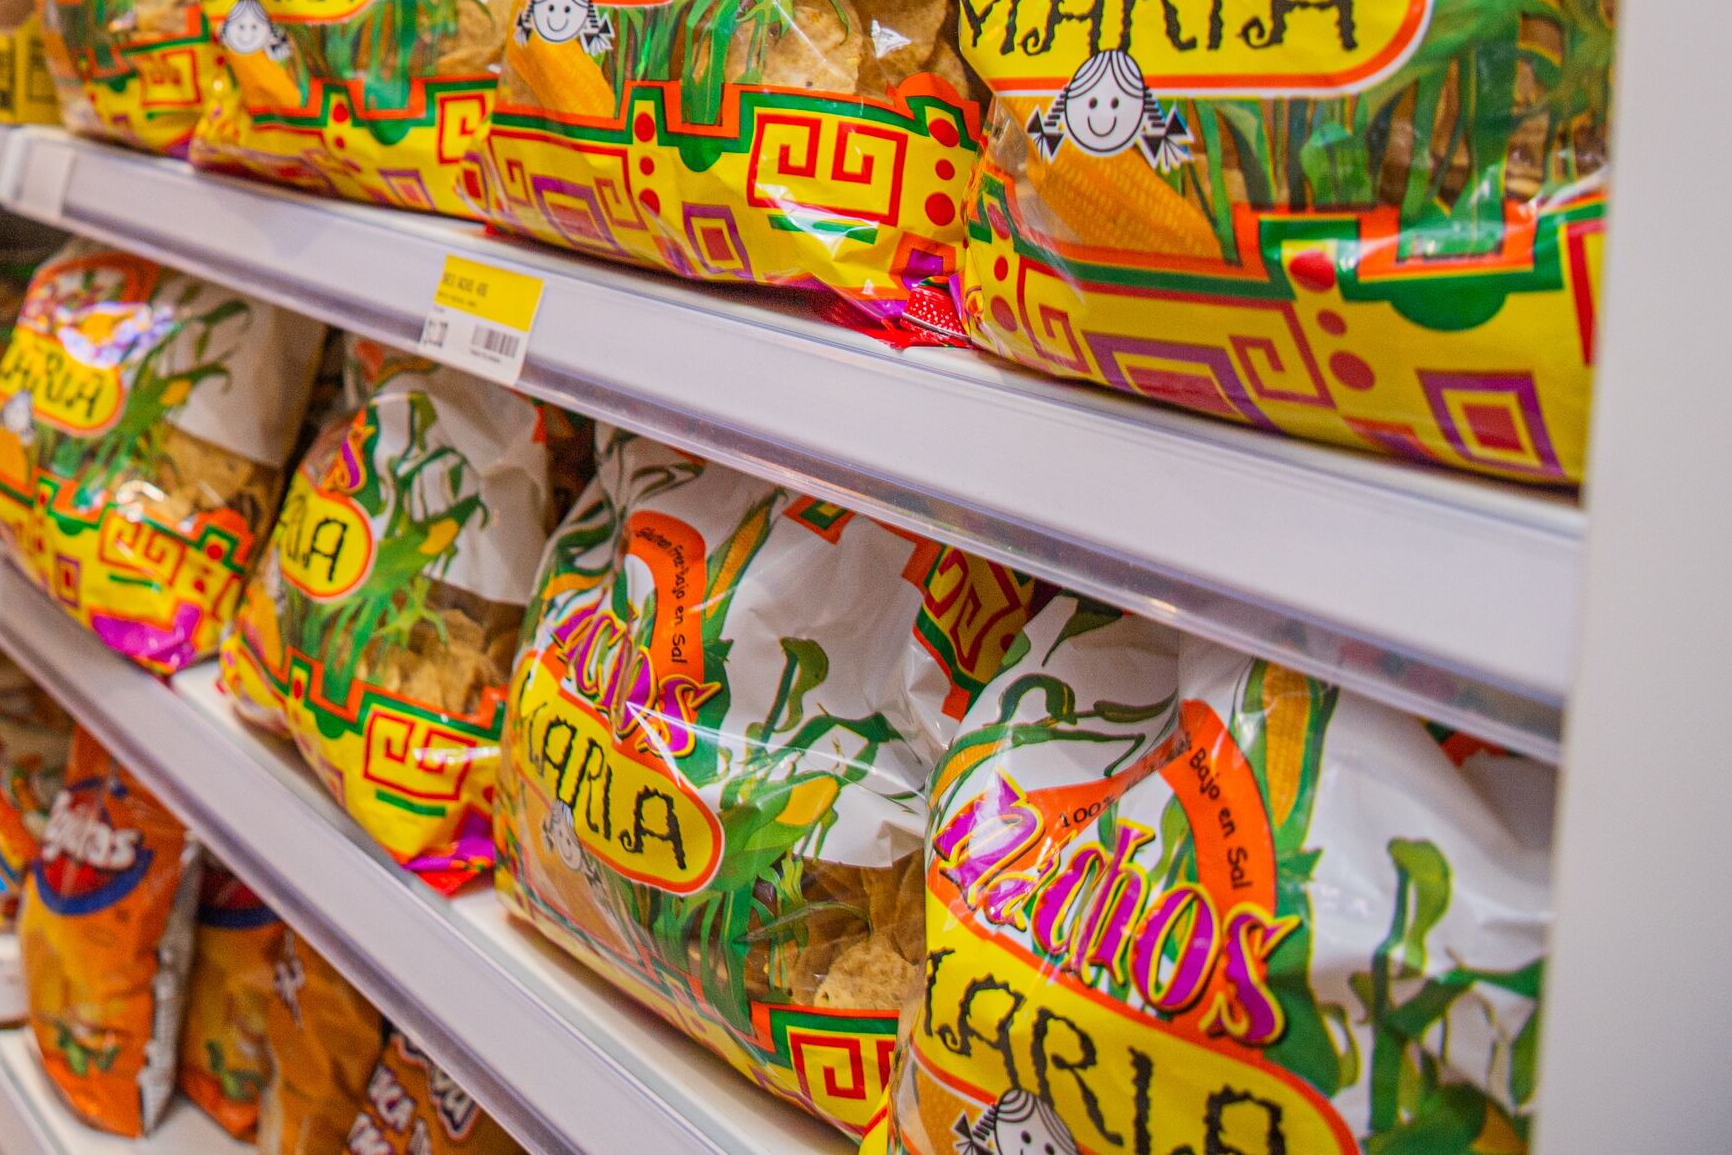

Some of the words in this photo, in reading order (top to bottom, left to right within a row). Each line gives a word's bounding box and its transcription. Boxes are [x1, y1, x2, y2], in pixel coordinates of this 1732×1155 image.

[0, 350, 106, 420] ARIA
[671, 633, 688, 664] Sal
[1189, 747, 1221, 801] Bajo
[1217, 806, 1237, 840] en
[1226, 846, 1253, 890] Sal
[934, 768, 1300, 1045] chos
